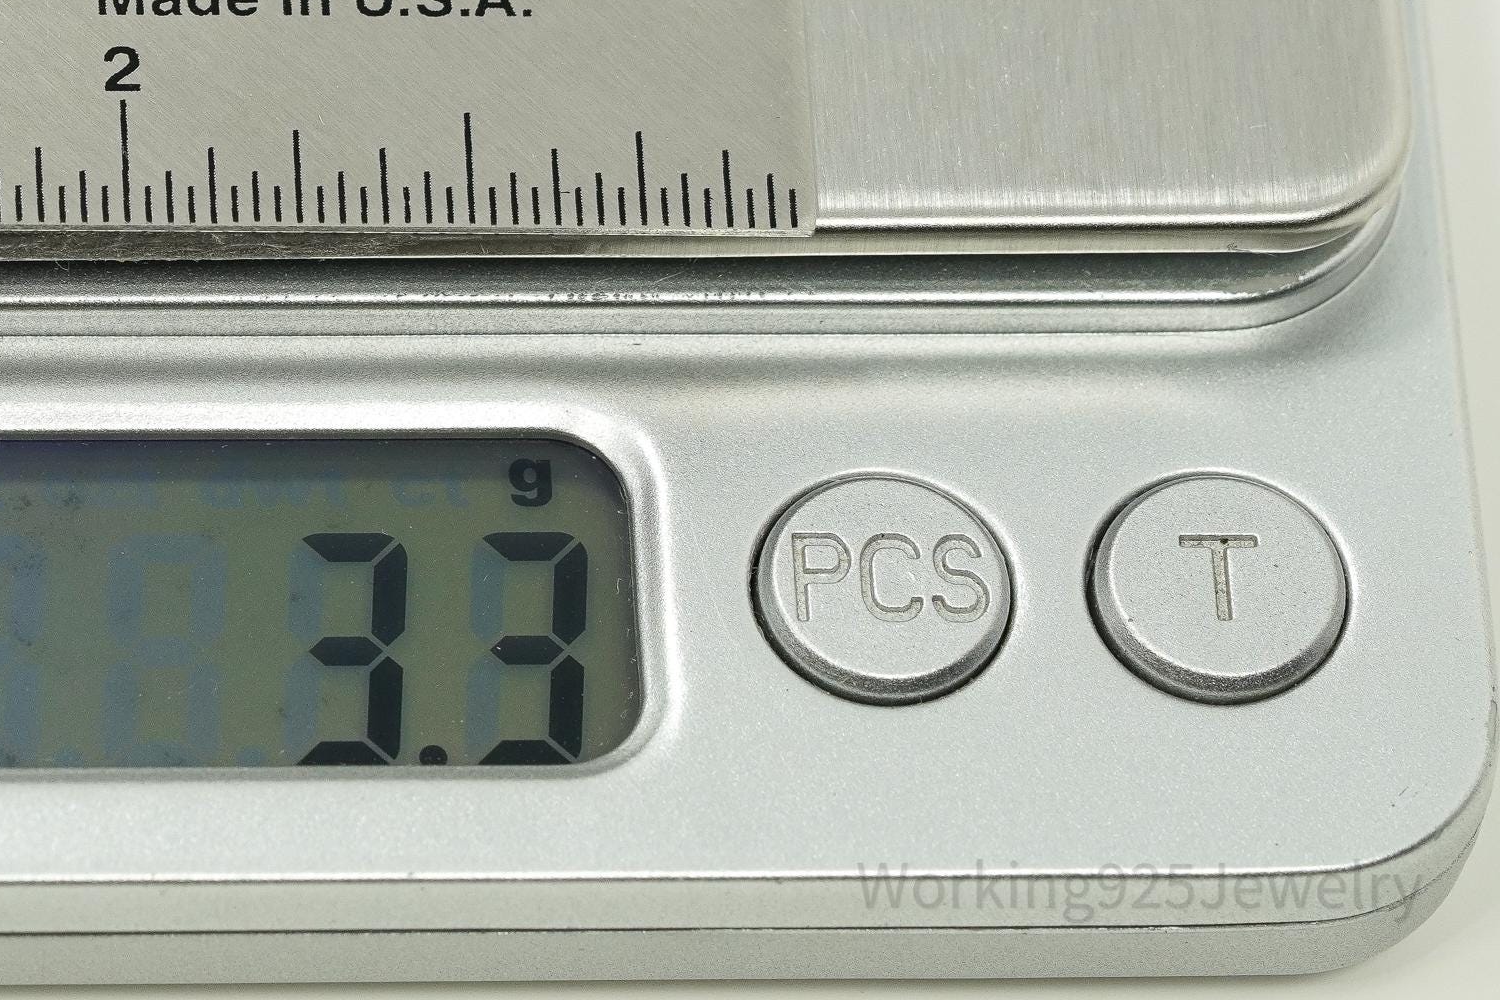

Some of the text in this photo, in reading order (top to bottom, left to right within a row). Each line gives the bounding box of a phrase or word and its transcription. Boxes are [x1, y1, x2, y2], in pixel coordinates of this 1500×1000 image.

[104, 46, 141, 92] 2
[508, 458, 552, 507] g
[791, 532, 991, 623] PCS
[1178, 534, 1258, 622] T
[298, 532, 588, 765] 3.3
